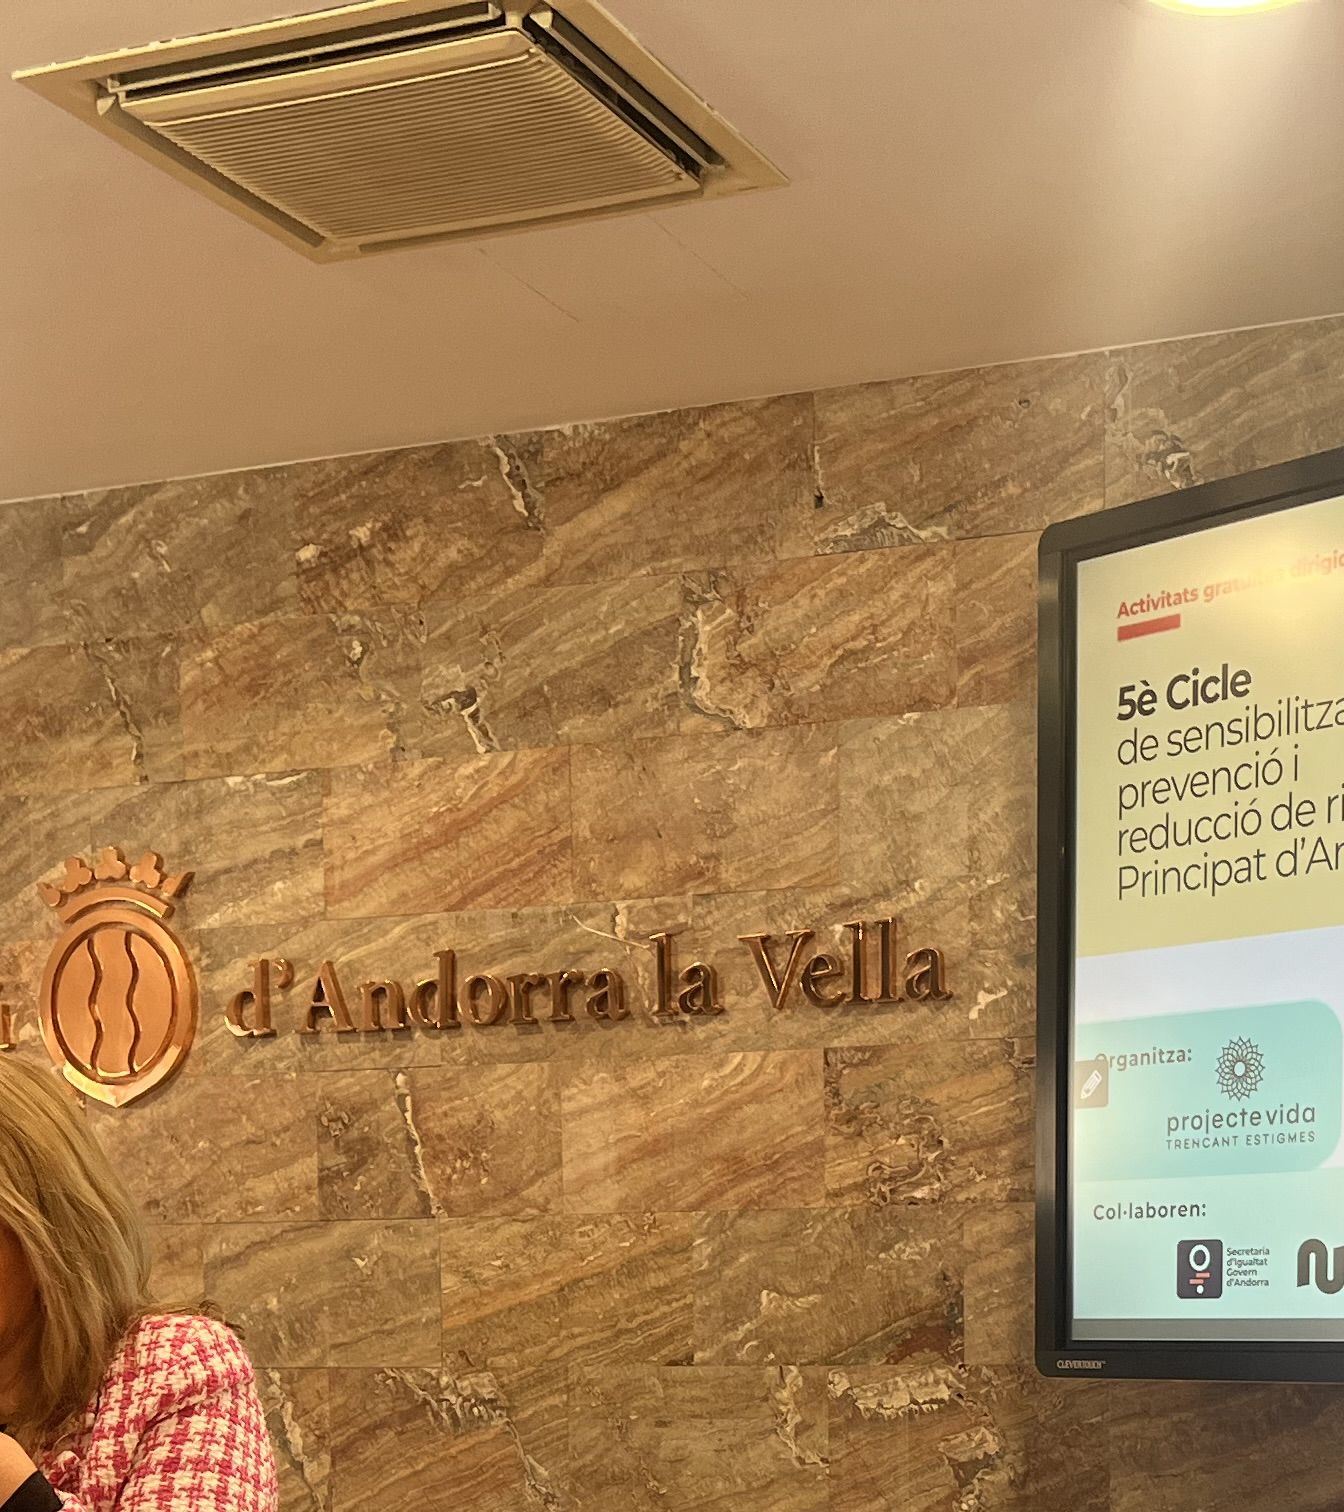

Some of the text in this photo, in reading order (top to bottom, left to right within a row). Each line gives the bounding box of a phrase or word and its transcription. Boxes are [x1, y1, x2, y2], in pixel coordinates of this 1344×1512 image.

[1117, 587, 1199, 619] Activitats
[1117, 664, 1252, 721] 5è Cicle
[1118, 726, 1159, 765] de
[1117, 743, 1300, 822] prevenció i
[1118, 797, 1262, 857] reducció
[1270, 791, 1316, 831] de
[1118, 848, 1267, 901] Principat
[223, 949, 633, 1038] d'Andorra
[648, 931, 725, 1021] la
[737, 917, 953, 1013] Vella
[1166, 1130, 1316, 1150] TRENCANT ESTIGMES
[1226, 1247, 1270, 1256] Secretaria
